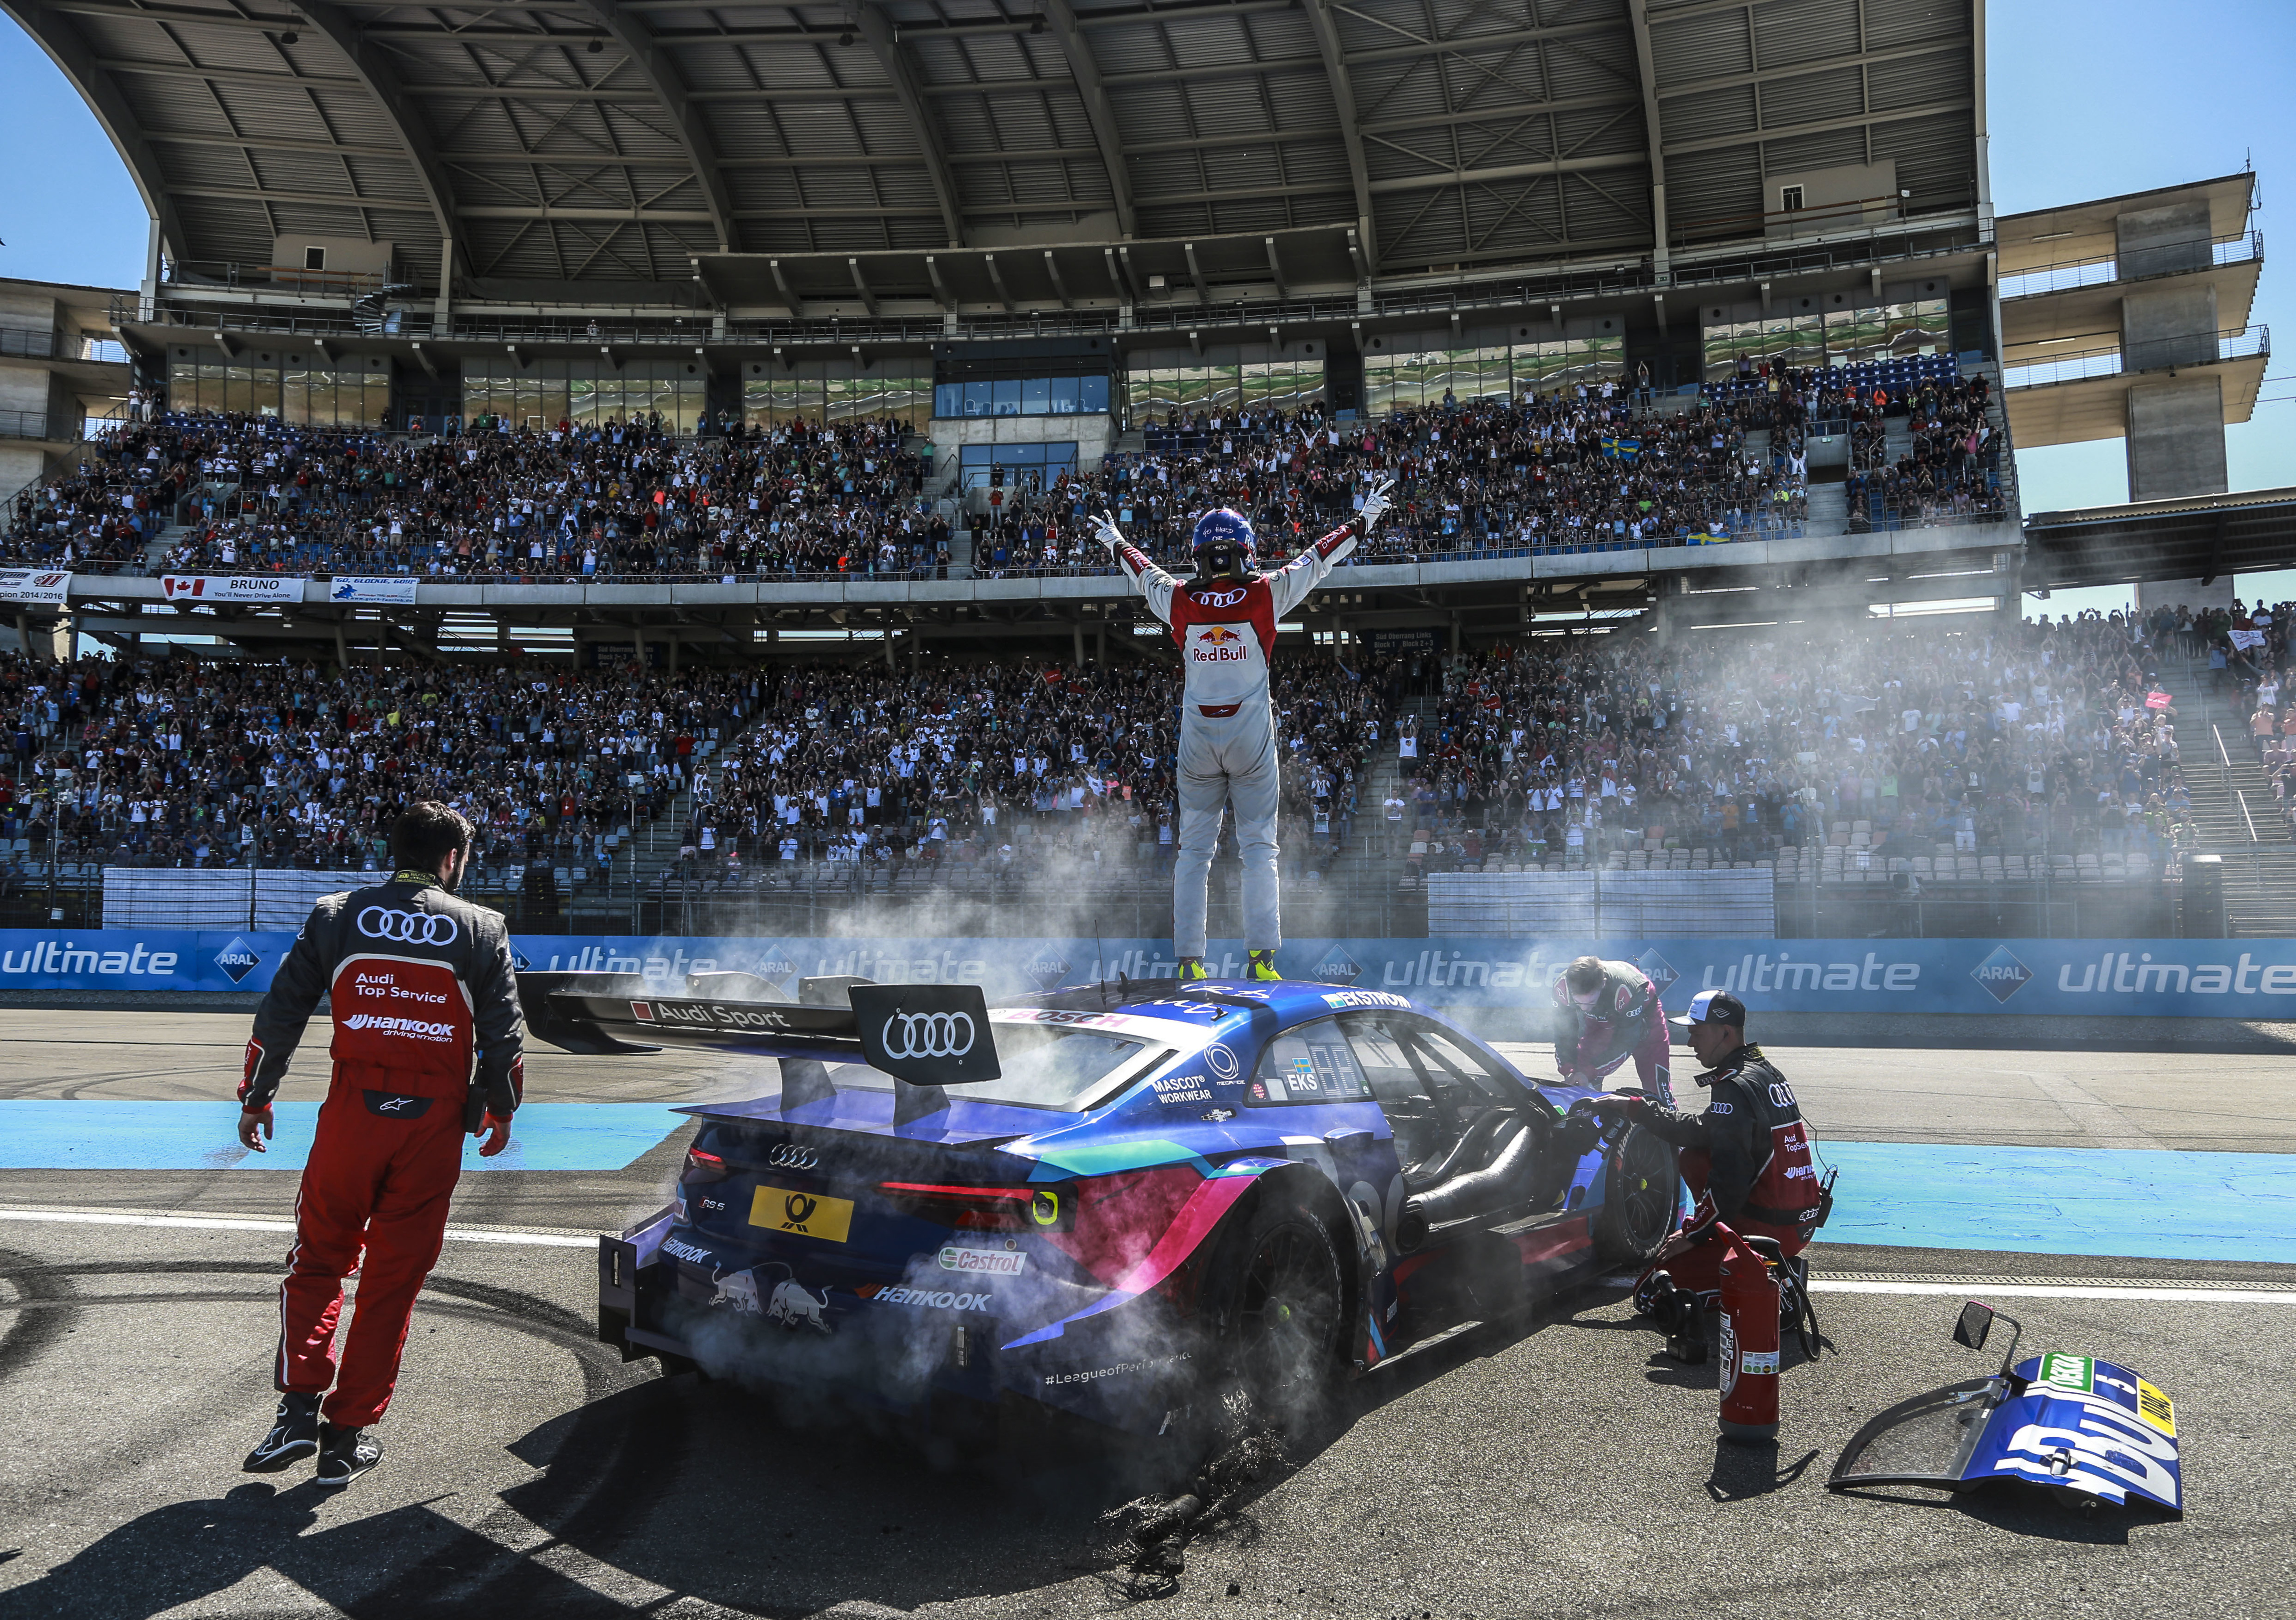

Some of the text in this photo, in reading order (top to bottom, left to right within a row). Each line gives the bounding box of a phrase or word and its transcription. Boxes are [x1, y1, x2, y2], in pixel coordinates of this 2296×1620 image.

[1203, 529, 1212, 537] GO
[230, 579, 279, 590] BRUNO
[20, 592, 63, 600] 2014/2016
[2, 941, 178, 975] ultimate
[220, 953, 254, 966] ARAL
[549, 947, 717, 980] ultimate
[758, 962, 792, 973] ARAL
[817, 951, 987, 984] ultimate
[1031, 962, 1065, 973] ARAL
[1319, 964, 1355, 976] ARAL
[1644, 968, 1672, 981] RAL
[1702, 953, 1920, 992] ultimate
[1979, 966, 2025, 980] ARAL
[2058, 953, 2296, 994] ultimate
[355, 972, 394, 985] Audi
[355, 984, 447, 1003] Top Service
[1340, 991, 1412, 1009] EKSTRÖM
[658, 1003, 790, 1028] Audi Sport
[1005, 1010, 1132, 1028] BOSCH
[382, 1029, 453, 1043] driving emotion
[1287, 1072, 1318, 1091] EKS
[1157, 1089, 1212, 1105] WORKWEAR
[702, 1198, 725, 1211] RS 5
[956, 1252, 1020, 1272] Castrol
[2049, 1352, 2085, 1388] DEKRA
[2095, 1374, 2137, 1395] 5
[2140, 1388, 2172, 1425] ADAC
